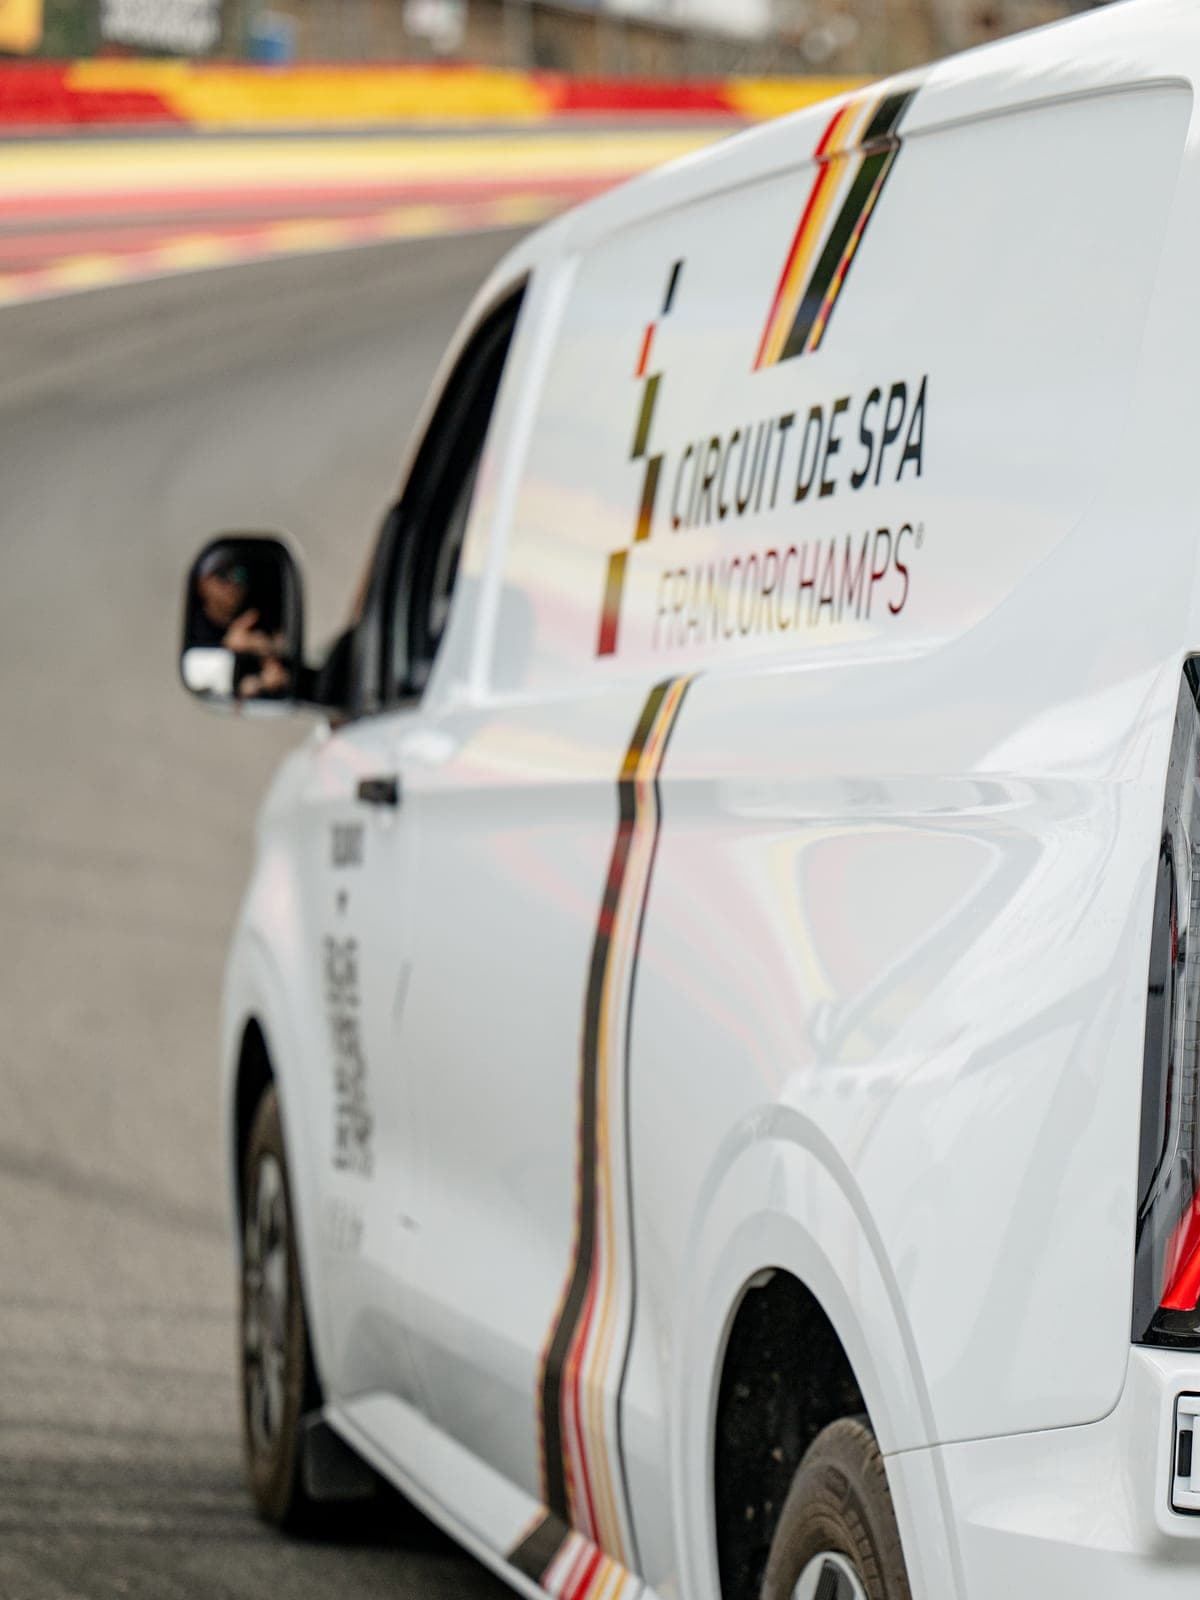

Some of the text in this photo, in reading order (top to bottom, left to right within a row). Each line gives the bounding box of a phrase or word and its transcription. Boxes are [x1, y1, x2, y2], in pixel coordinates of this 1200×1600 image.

[671, 374, 929, 533] CIRCUIT DE SPA
